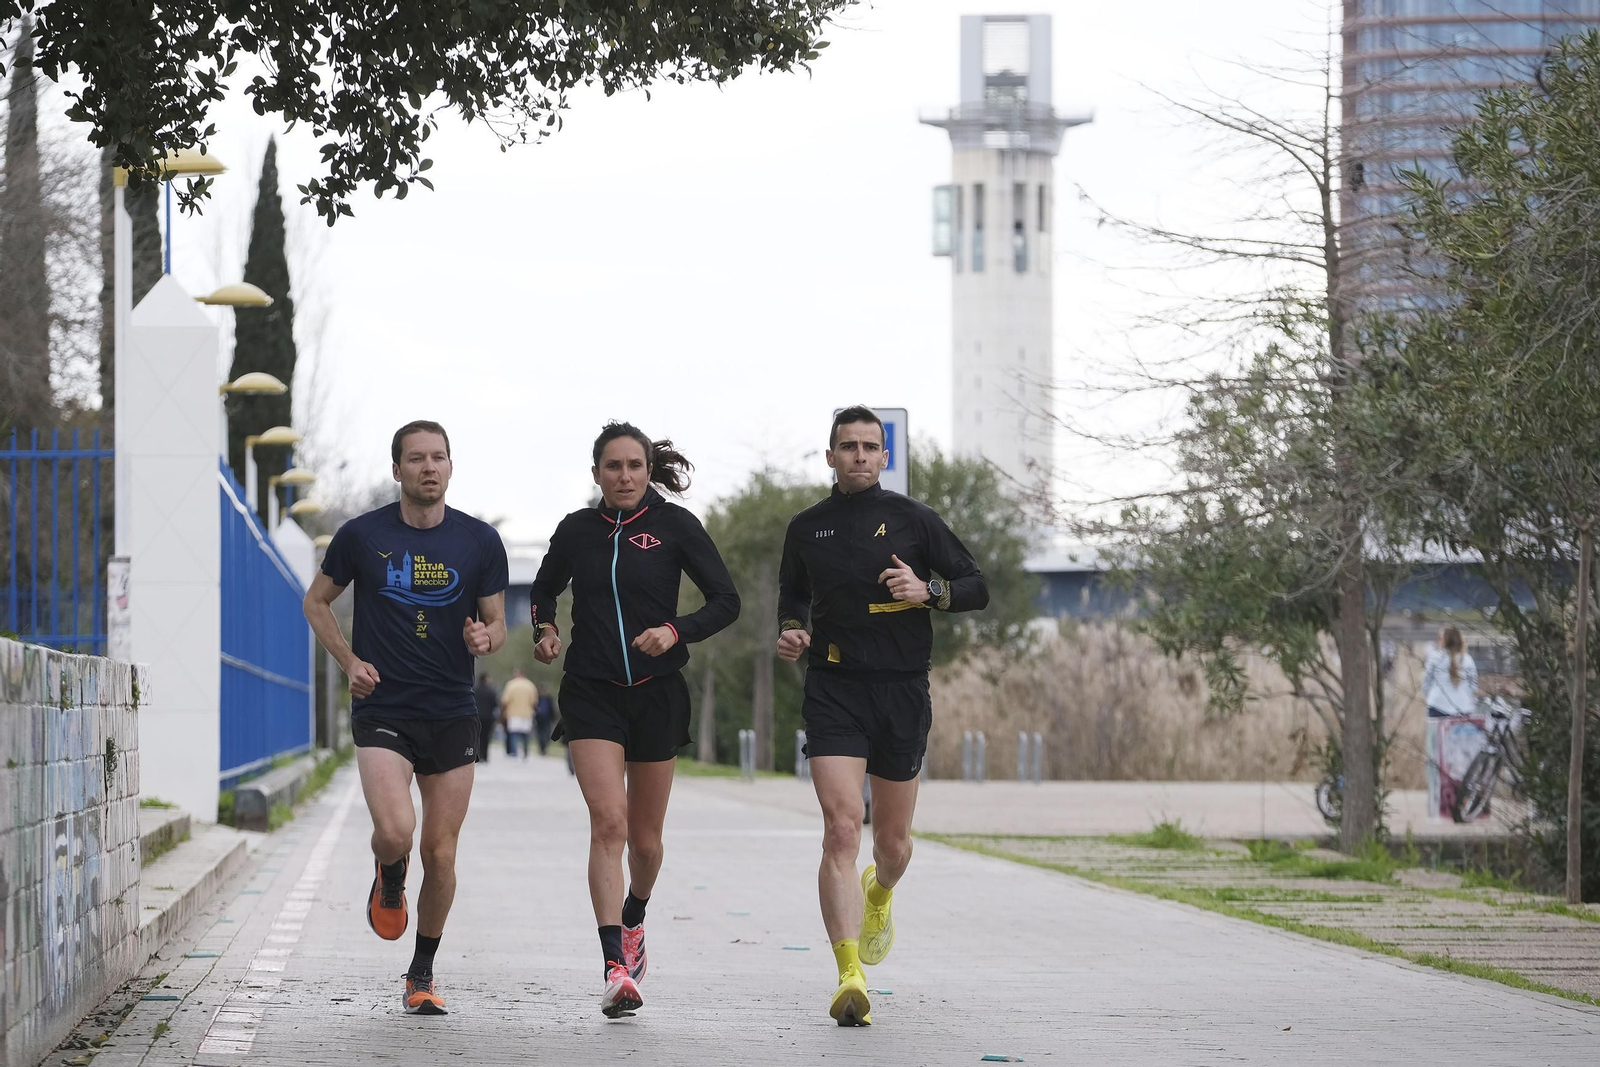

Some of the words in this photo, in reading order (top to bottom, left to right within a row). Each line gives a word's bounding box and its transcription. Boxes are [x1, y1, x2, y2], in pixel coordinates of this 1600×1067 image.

[414, 555, 426, 563] 41
[414, 563, 445, 571] MITJA
[414, 571, 449, 579] SITGES
